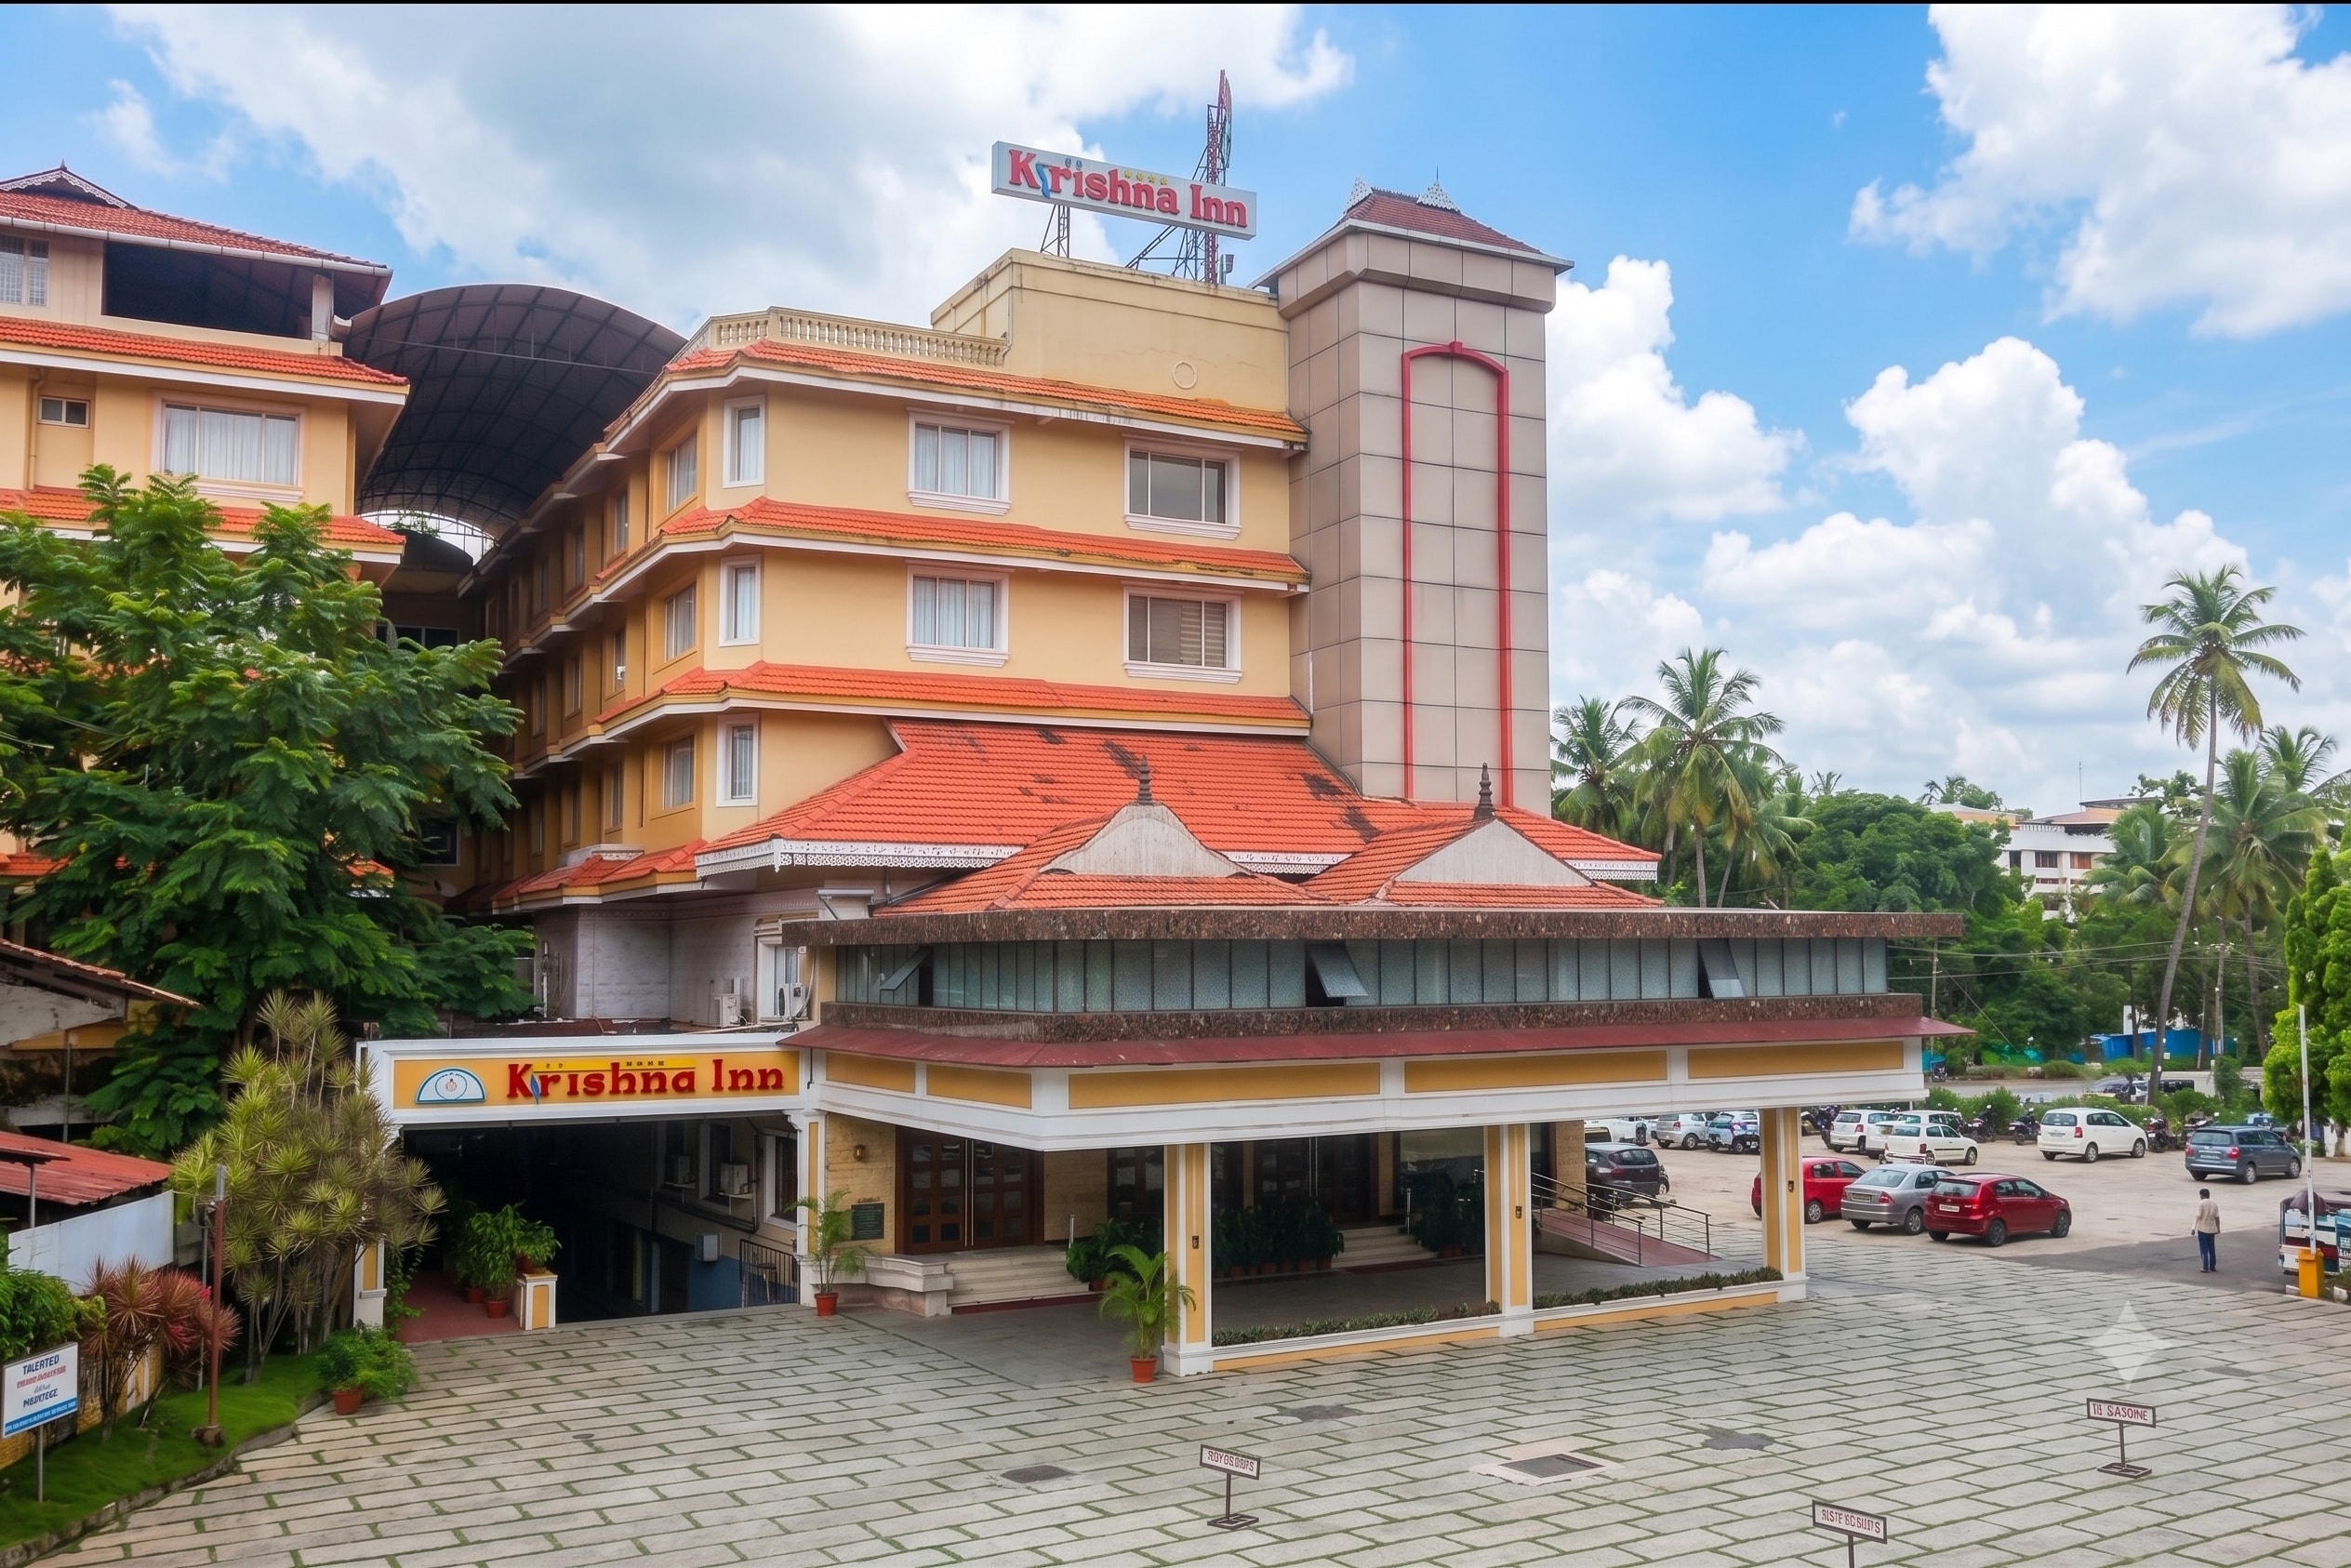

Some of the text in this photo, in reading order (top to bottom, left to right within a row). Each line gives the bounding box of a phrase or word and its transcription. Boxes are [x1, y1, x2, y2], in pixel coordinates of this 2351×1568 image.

[1008, 149, 1248, 228] Krishna Inn
[507, 1058, 784, 1098] Krishna Inn
